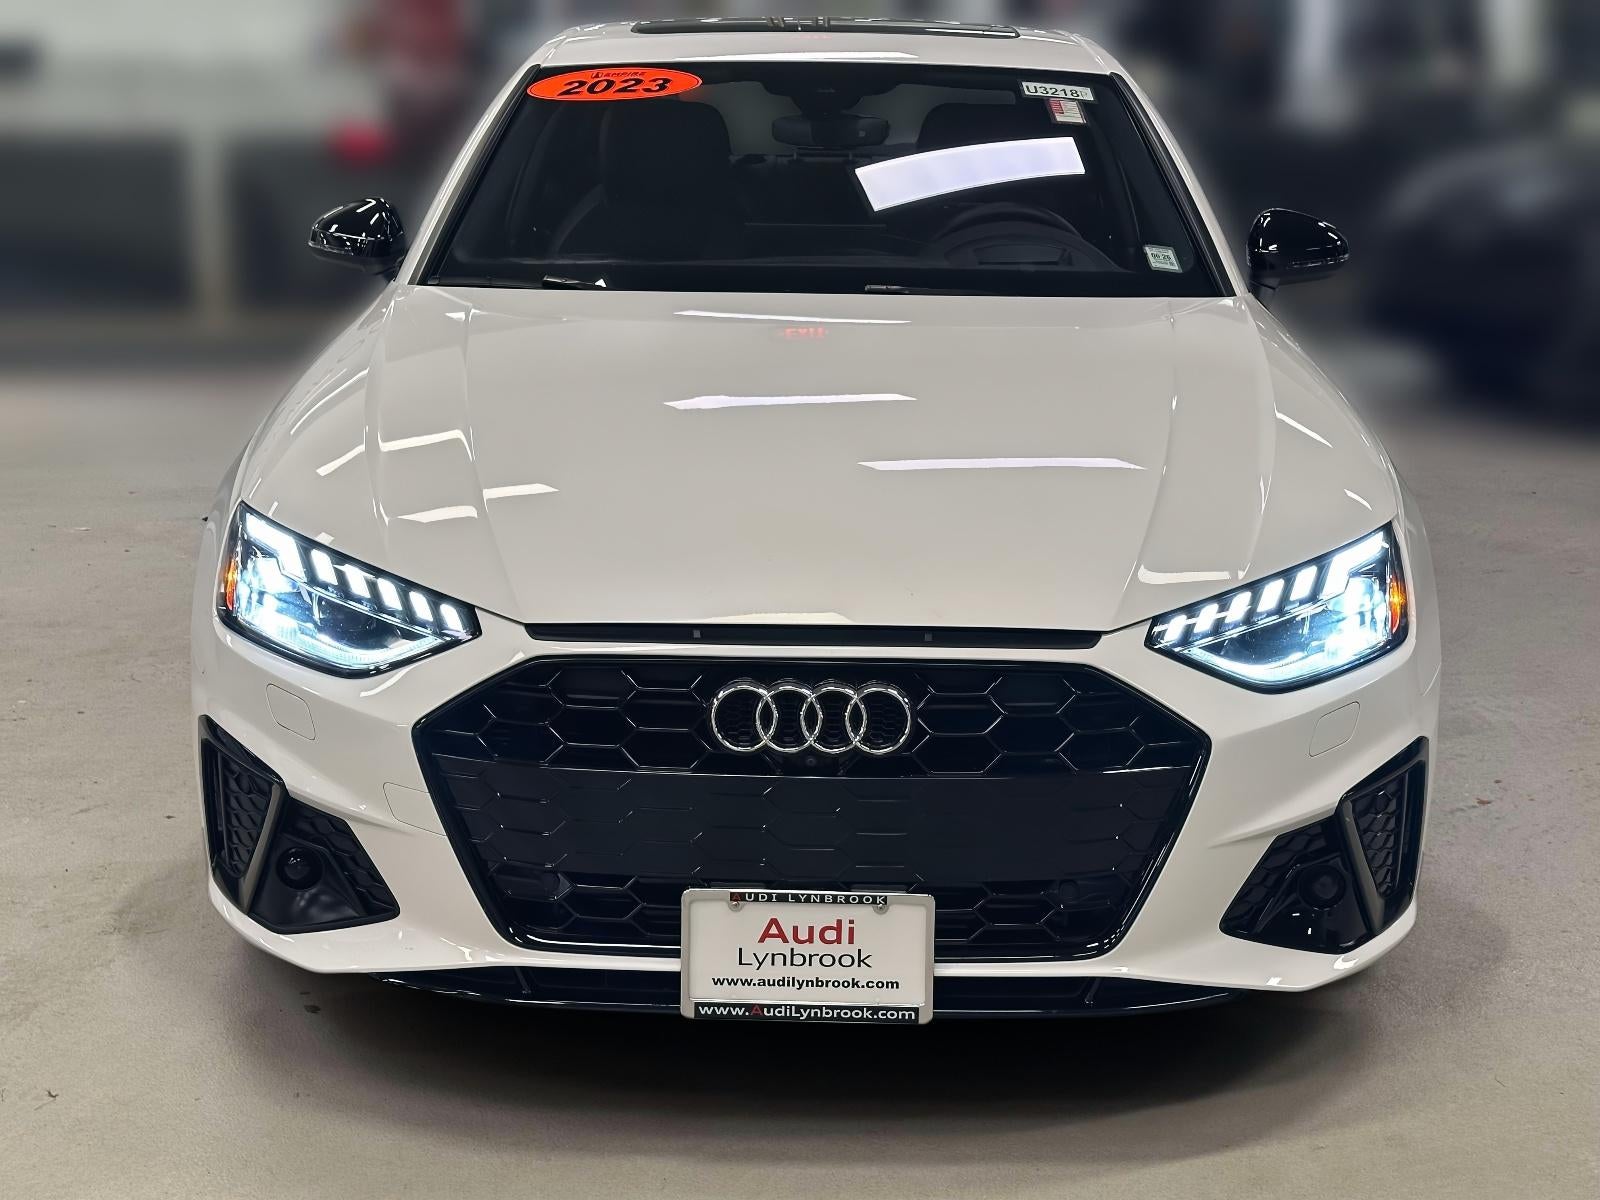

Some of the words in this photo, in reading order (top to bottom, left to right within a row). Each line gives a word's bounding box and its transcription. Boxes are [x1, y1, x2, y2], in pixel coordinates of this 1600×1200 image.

[558, 78, 672, 96] 2023
[731, 892, 778, 903] AUDI
[788, 893, 886, 905] LYNBROOK
[757, 917, 855, 945] Audi
[738, 947, 872, 971] Lynbrook
[711, 976, 900, 990] www.audilynbrook.com
[699, 1003, 915, 1020] www.AudiLynbrook.com
